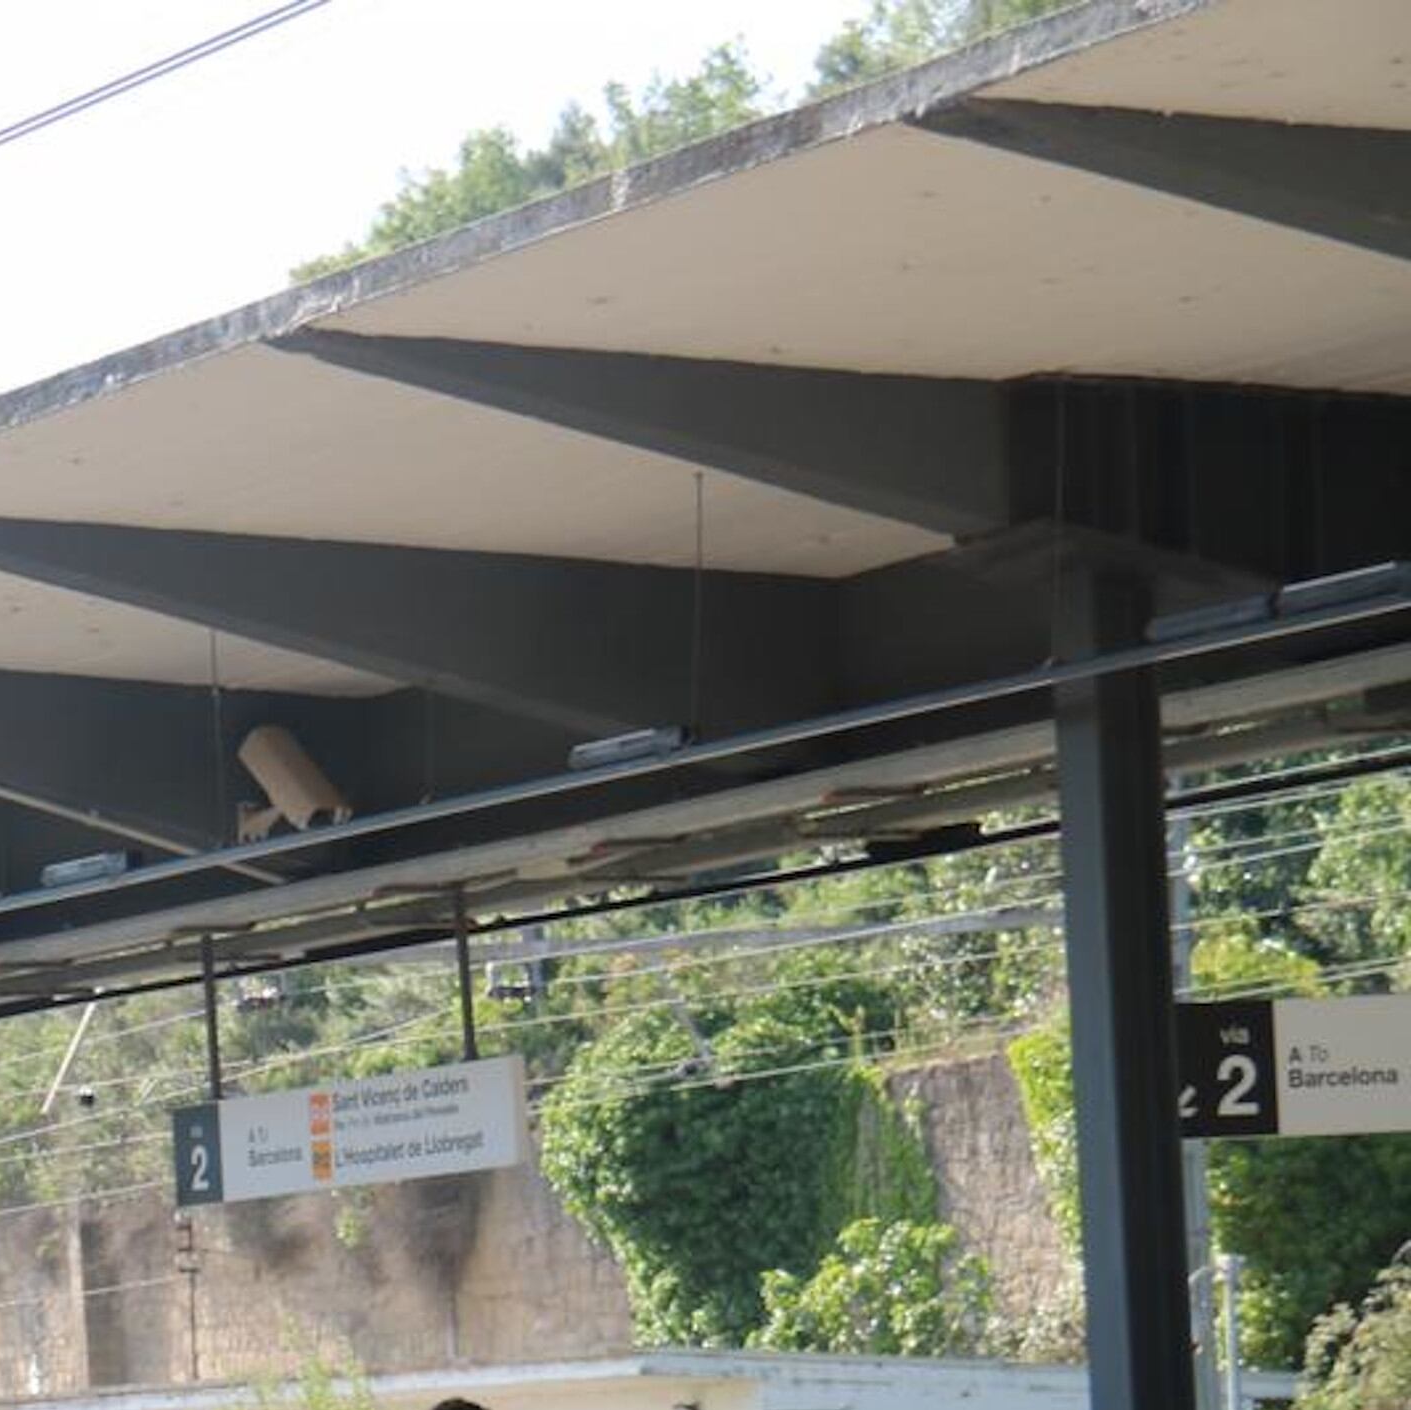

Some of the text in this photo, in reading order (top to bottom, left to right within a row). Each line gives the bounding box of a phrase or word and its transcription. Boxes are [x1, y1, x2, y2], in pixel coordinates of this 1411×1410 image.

[1220, 1024, 1250, 1045] via
[1289, 1045, 1328, 1062] A To
[1217, 1055, 1260, 1116] 2
[1288, 1066, 1398, 1089] Barcelona
[403, 1081, 419, 1100] de
[408, 1137, 422, 1157] de
[191, 1145, 209, 1191] 2
